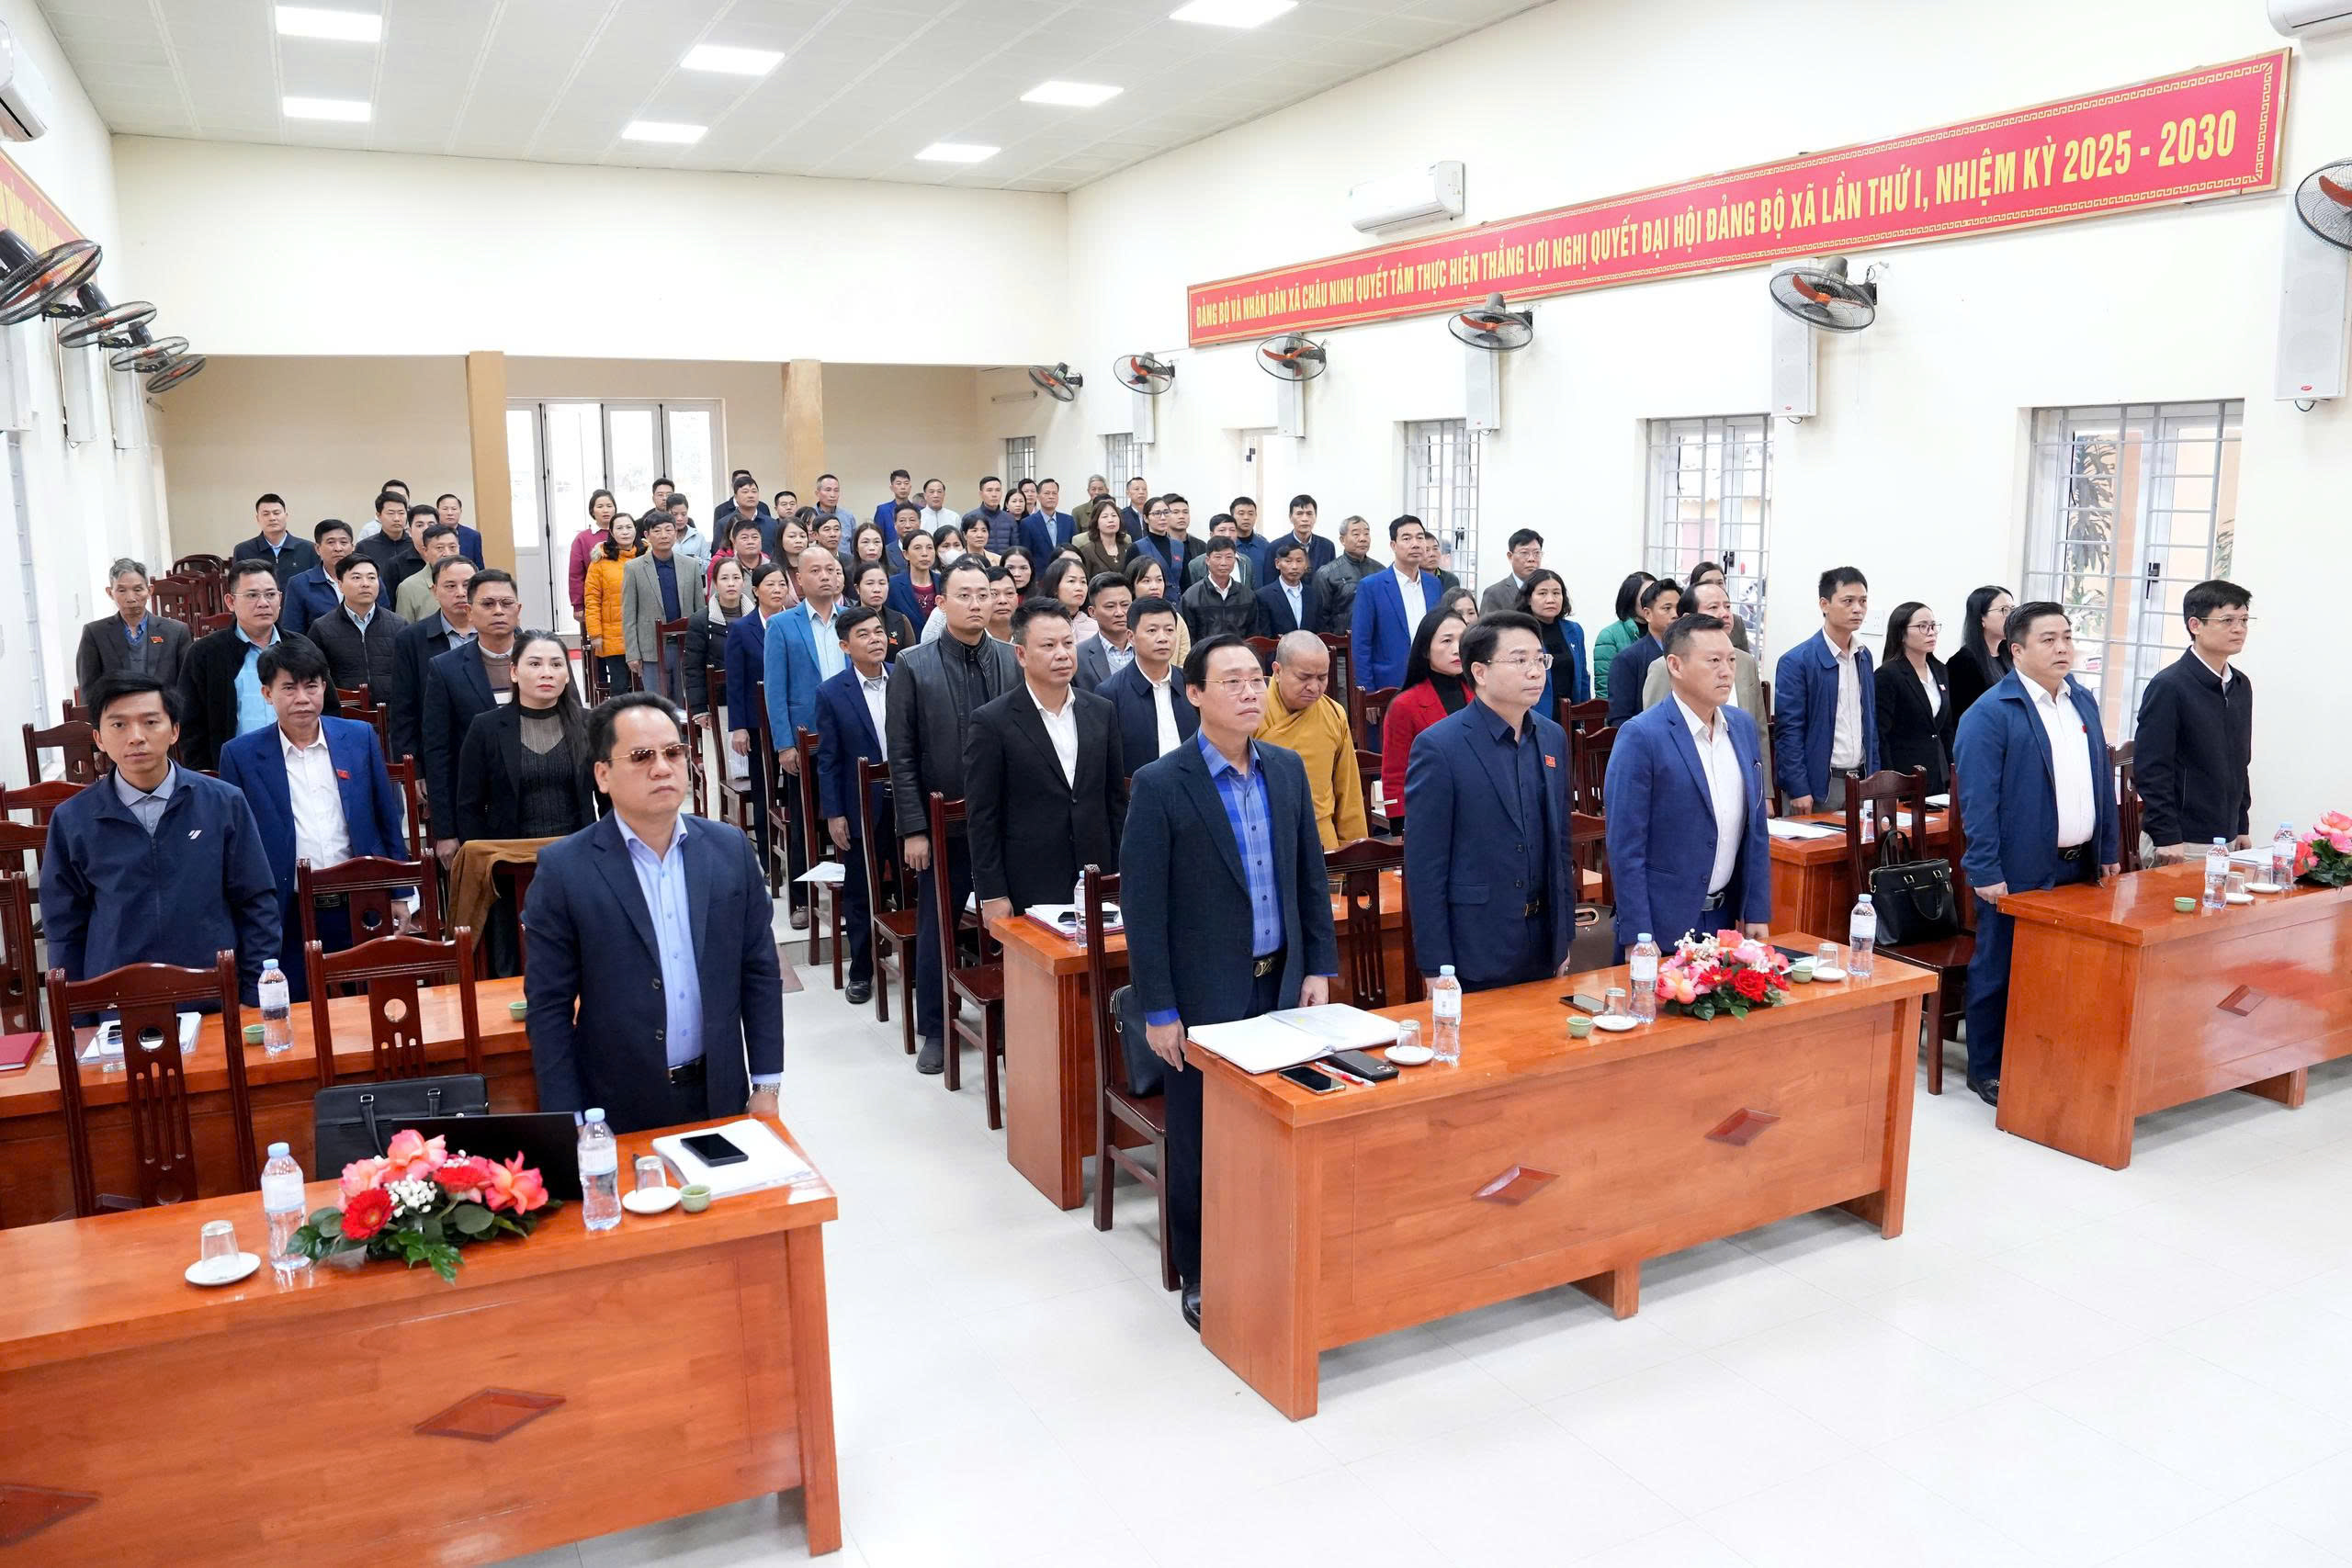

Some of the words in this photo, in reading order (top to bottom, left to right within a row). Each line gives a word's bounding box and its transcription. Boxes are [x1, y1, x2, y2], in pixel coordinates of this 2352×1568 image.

[1196, 298, 1217, 328] ĐẢNG
[1219, 296, 1229, 328] BỘ
[1231, 294, 1241, 322] VÀ
[1243, 291, 1266, 321] NHÂN
[1268, 287, 1287, 316] DÂN
[1303, 279, 1327, 310] CHÂU
[1329, 279, 1354, 305] NINH
[1356, 264, 1387, 304] QUYẾT
[1390, 263, 1414, 295] TÂM
[1417, 258, 1446, 295] THỰC
[1450, 250, 1478, 290] HIỆN
[1481, 238, 1524, 281] THẮNG
[1528, 238, 1549, 278] LỢI
[1553, 233, 1588, 271] NGHỊ
[1590, 214, 1637, 262] QUYẾT
[1642, 218, 1668, 258] ĐẠI
[1673, 206, 1702, 253] HỘI
[1706, 194, 1755, 241] ĐẢNG
[1760, 188, 1784, 239] BỘ
[1790, 184, 1816, 229] XÃ
[1821, 171, 1862, 224] LẦN
[1867, 164, 1912, 217] THỨ
[1915, 169, 1928, 213] I,
[1935, 147, 2016, 206] NHIỆM
[2023, 136, 2057, 190] KỲ
[2062, 130, 2132, 184] 2025
[2140, 146, 2151, 157] -
[2158, 109, 2237, 168] 2030
